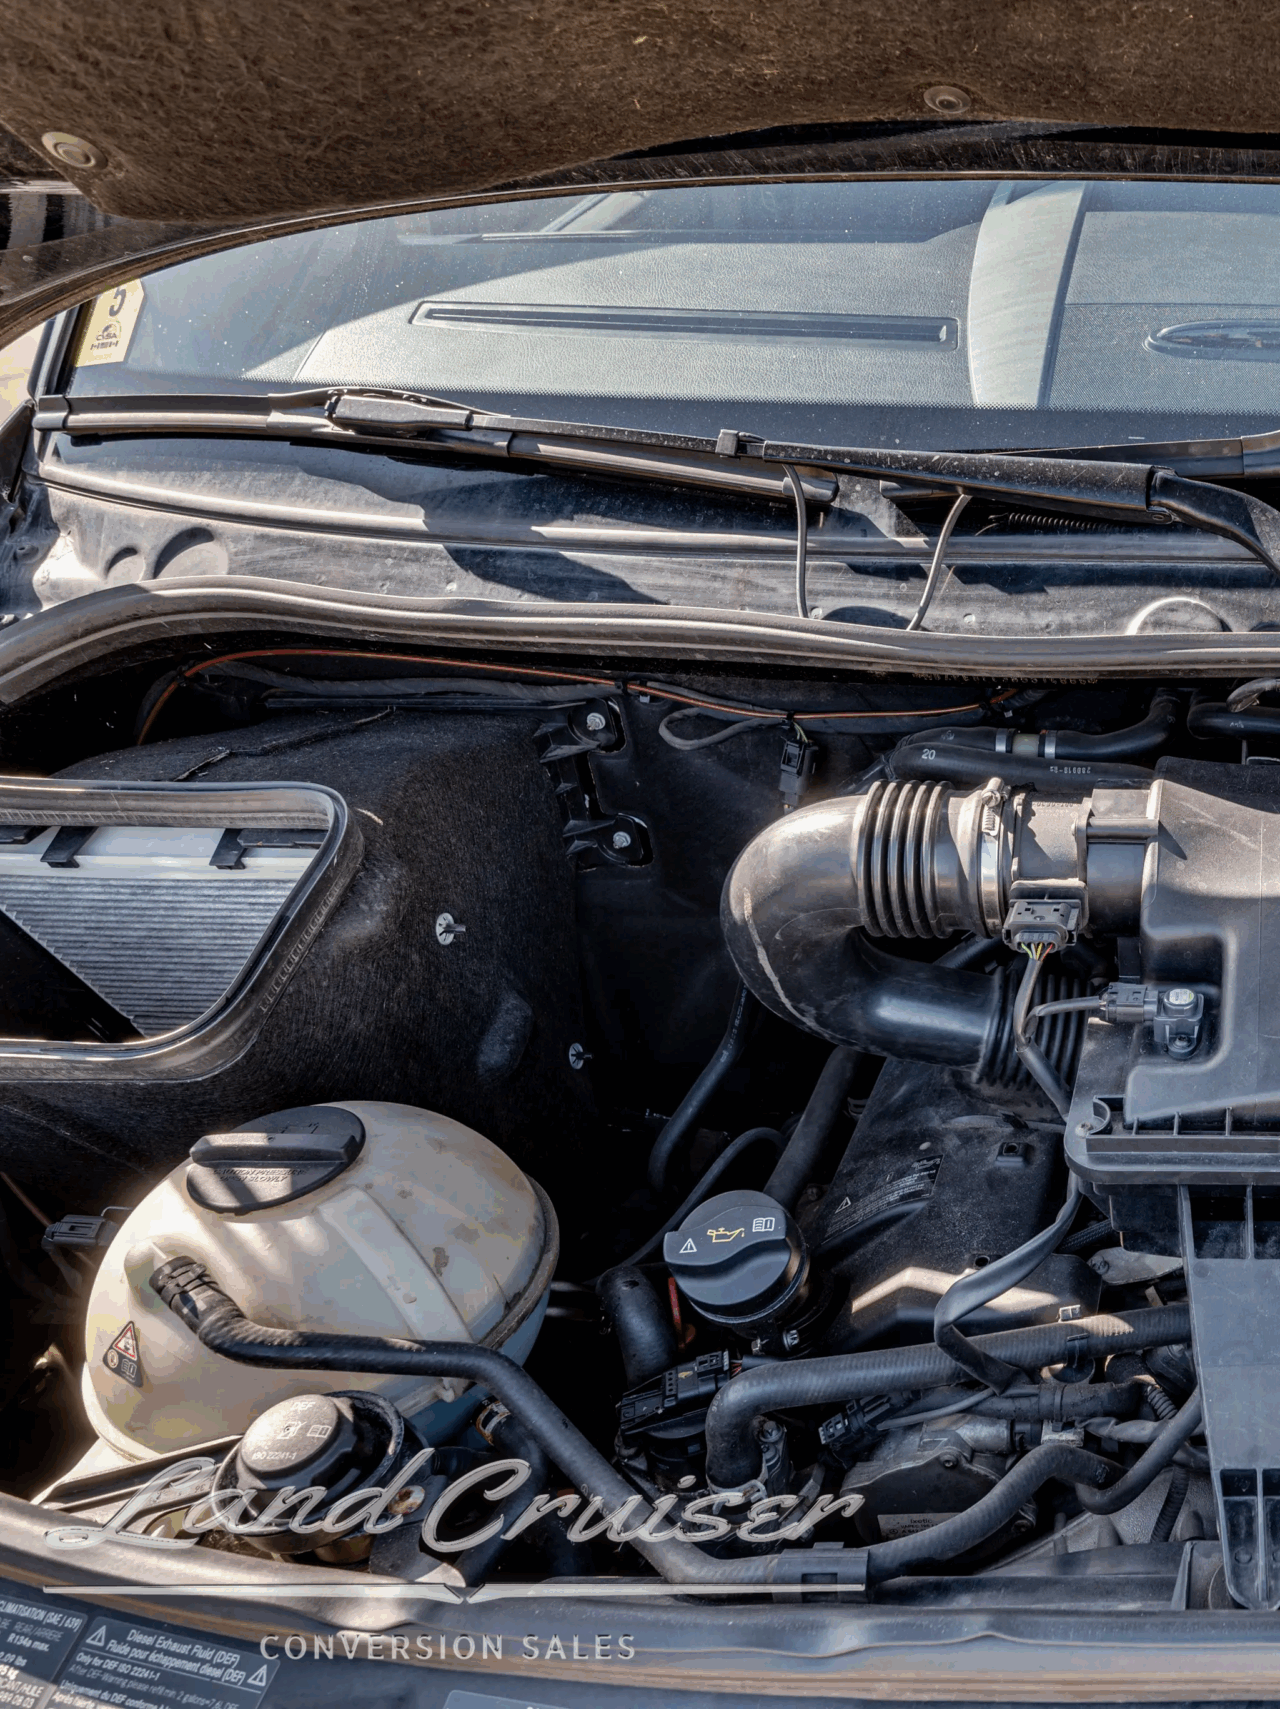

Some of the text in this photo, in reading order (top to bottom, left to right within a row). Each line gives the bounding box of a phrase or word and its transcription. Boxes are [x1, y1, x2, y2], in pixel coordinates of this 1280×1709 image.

[921, 748, 936, 760] 20
[290, 1402, 316, 1411] DEF
[6, 1633, 33, 1648] R134a
[126, 1629, 241, 1668] Diesel Exhaust Fluid (DEF)
[75, 1652, 161, 1681] Only for DEF ISO 22241-1
[106, 1639, 131, 1655] Fluide
[128, 1647, 150, 1660] pour
[199, 1663, 225, 1679] diesel
[221, 1669, 247, 1686] (DEF)
[109, 1692, 128, 1703] DEF
